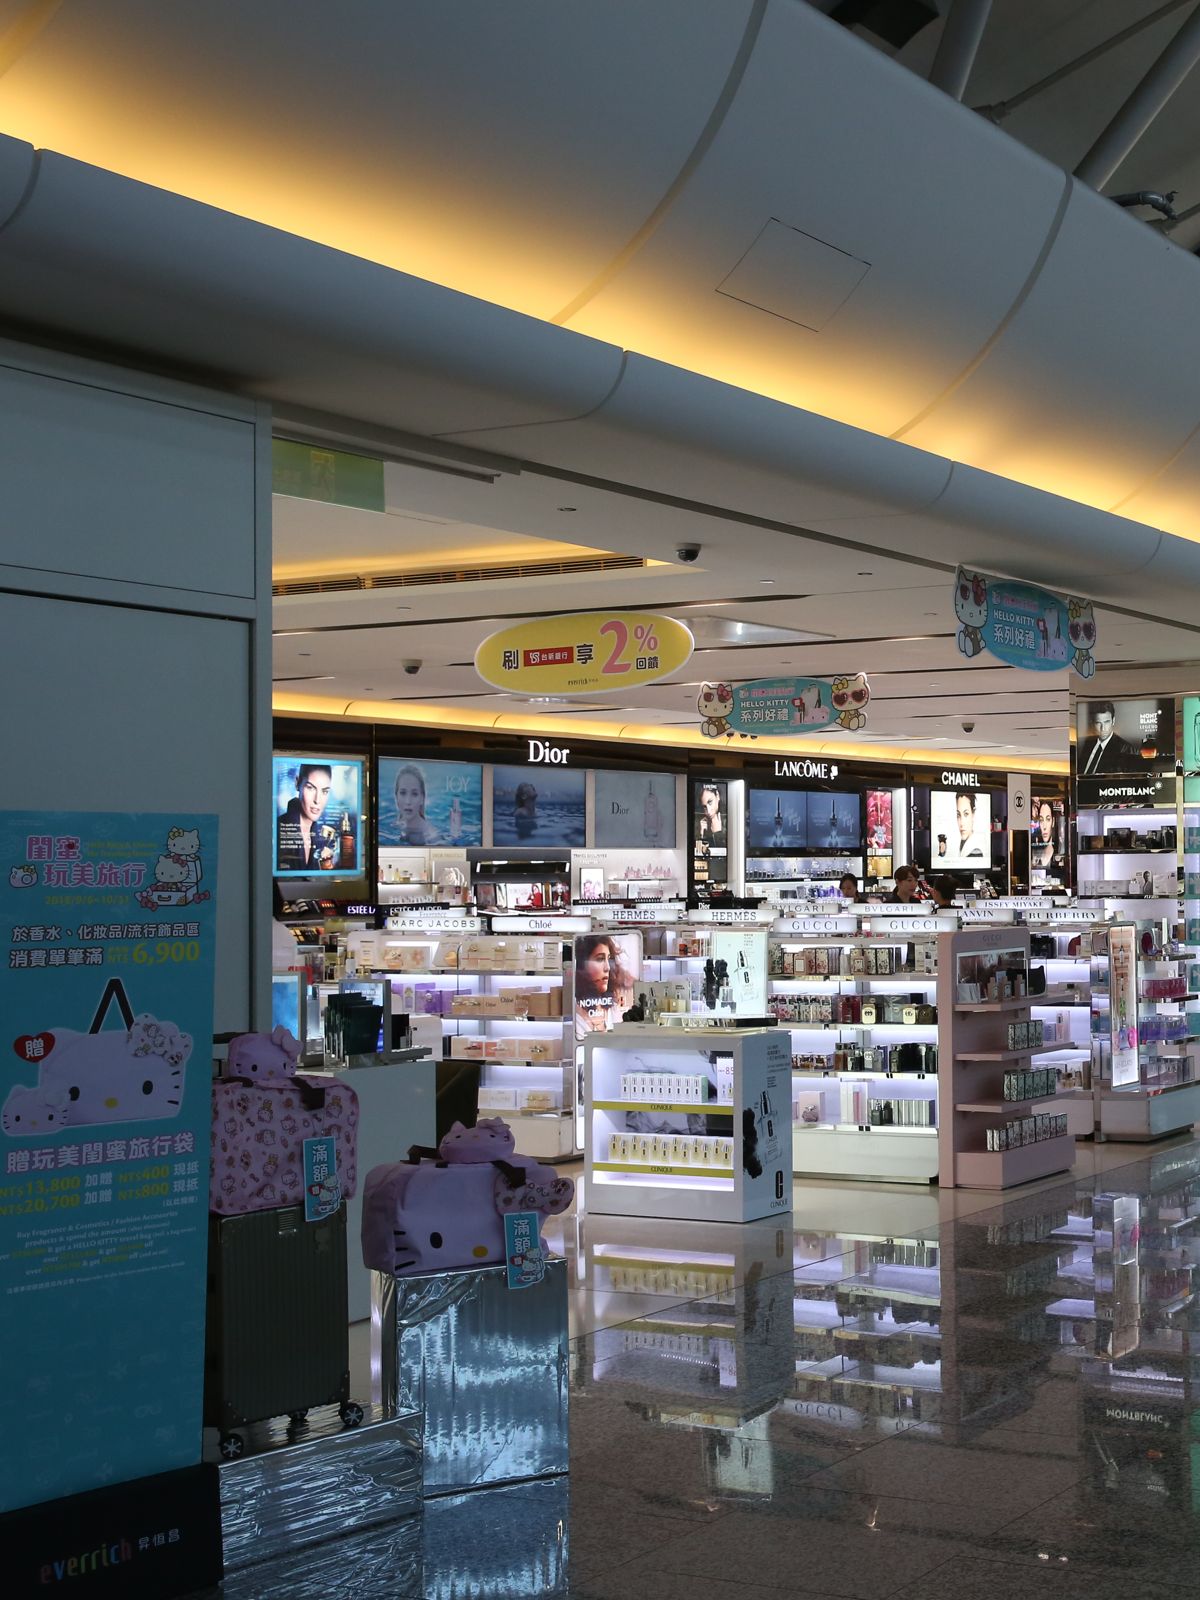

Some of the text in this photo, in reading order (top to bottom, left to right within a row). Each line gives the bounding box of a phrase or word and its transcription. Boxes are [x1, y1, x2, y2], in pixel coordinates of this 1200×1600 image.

[993, 609, 1035, 626] HELLO KITTY
[993, 624, 1035, 650] 系列好禮
[502, 649, 519, 670] 刷
[576, 643, 594, 665] 享
[600, 619, 658, 674] 2%
[740, 708, 789, 722] 系列好禮
[528, 740, 570, 765] Dior
[774, 760, 828, 779] LANCÔME
[443, 776, 471, 793] JOY
[941, 771, 981, 787] CHANEL
[1099, 786, 1156, 797] MONTBLANC
[611, 802, 630, 815] Dior
[26, 835, 82, 861] 閨蜜
[42, 862, 147, 888] 玩美旅行
[347, 905, 367, 914] ESTÉE
[864, 905, 914, 913] BVLGARI
[957, 910, 994, 918] LANVIN
[1029, 911, 1097, 920] BURBERRY
[392, 920, 476, 928] MARC JACOBS
[528, 917, 552, 929] Chloé
[792, 921, 838, 930] GUCCI
[890, 920, 938, 930] GUCCI
[10, 947, 104, 968] 消費單筆滿
[132, 941, 200, 966] 6,900
[580, 996, 613, 1008] NOMADE
[25, 1038, 44, 1058] 贈
[6, 1131, 195, 1174] 贈玩美閨蜜旅行袋
[312, 1144, 329, 1182] 滿額
[770, 1199, 788, 1209] CLINIQUE
[513, 1219, 531, 1253] 滿額
[40, 1538, 133, 1585] everrich
